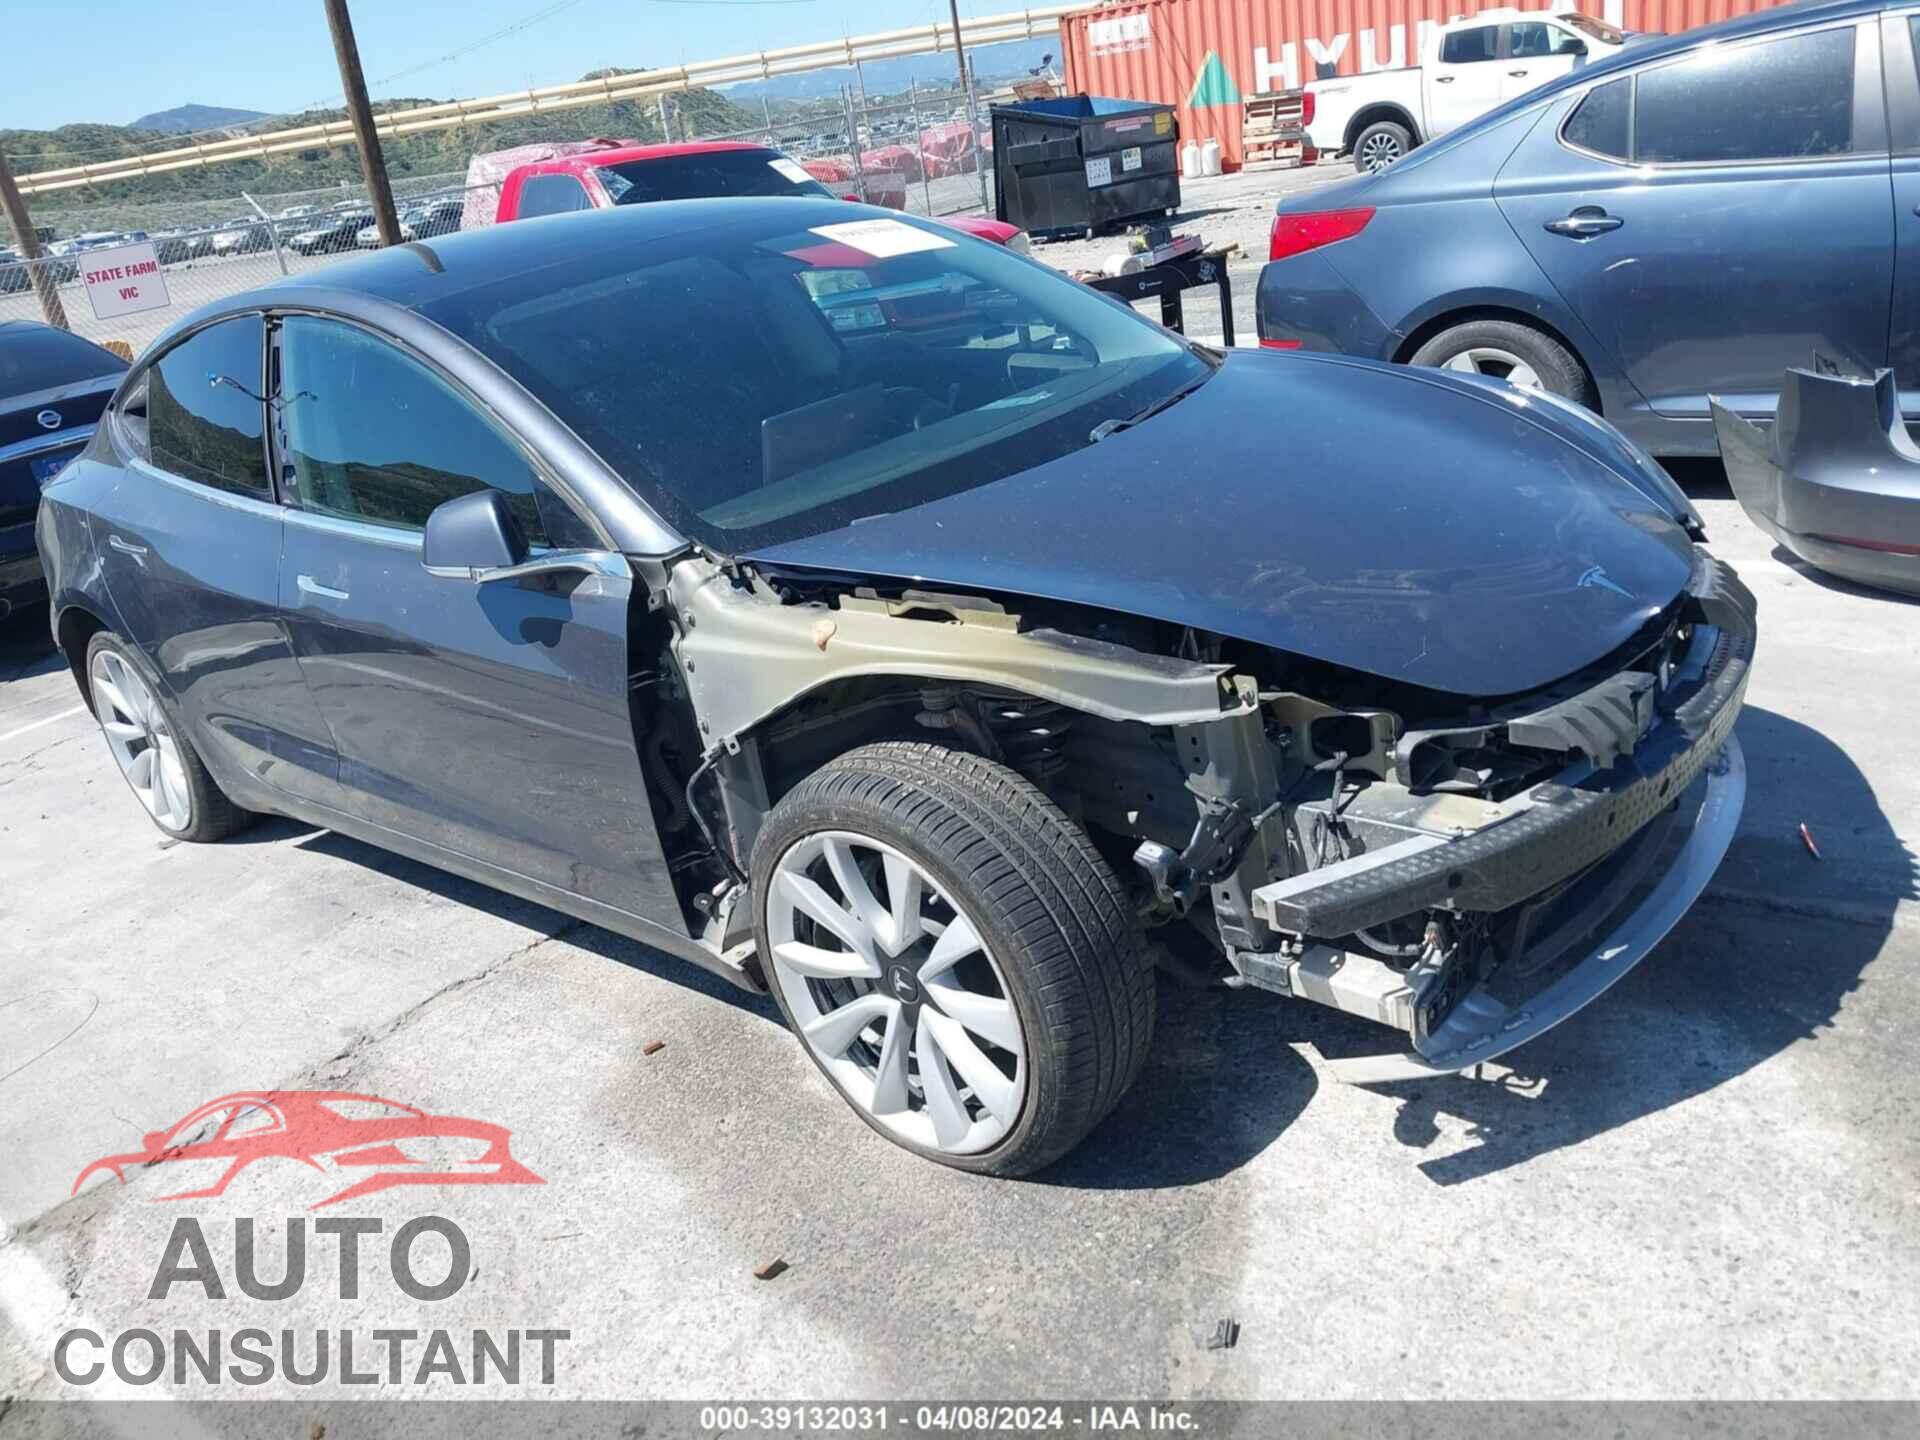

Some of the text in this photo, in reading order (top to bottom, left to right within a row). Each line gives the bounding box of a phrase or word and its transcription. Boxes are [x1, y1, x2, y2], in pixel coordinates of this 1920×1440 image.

[86, 261, 158, 285] STATE FARM
[119, 286, 140, 300] VIC
